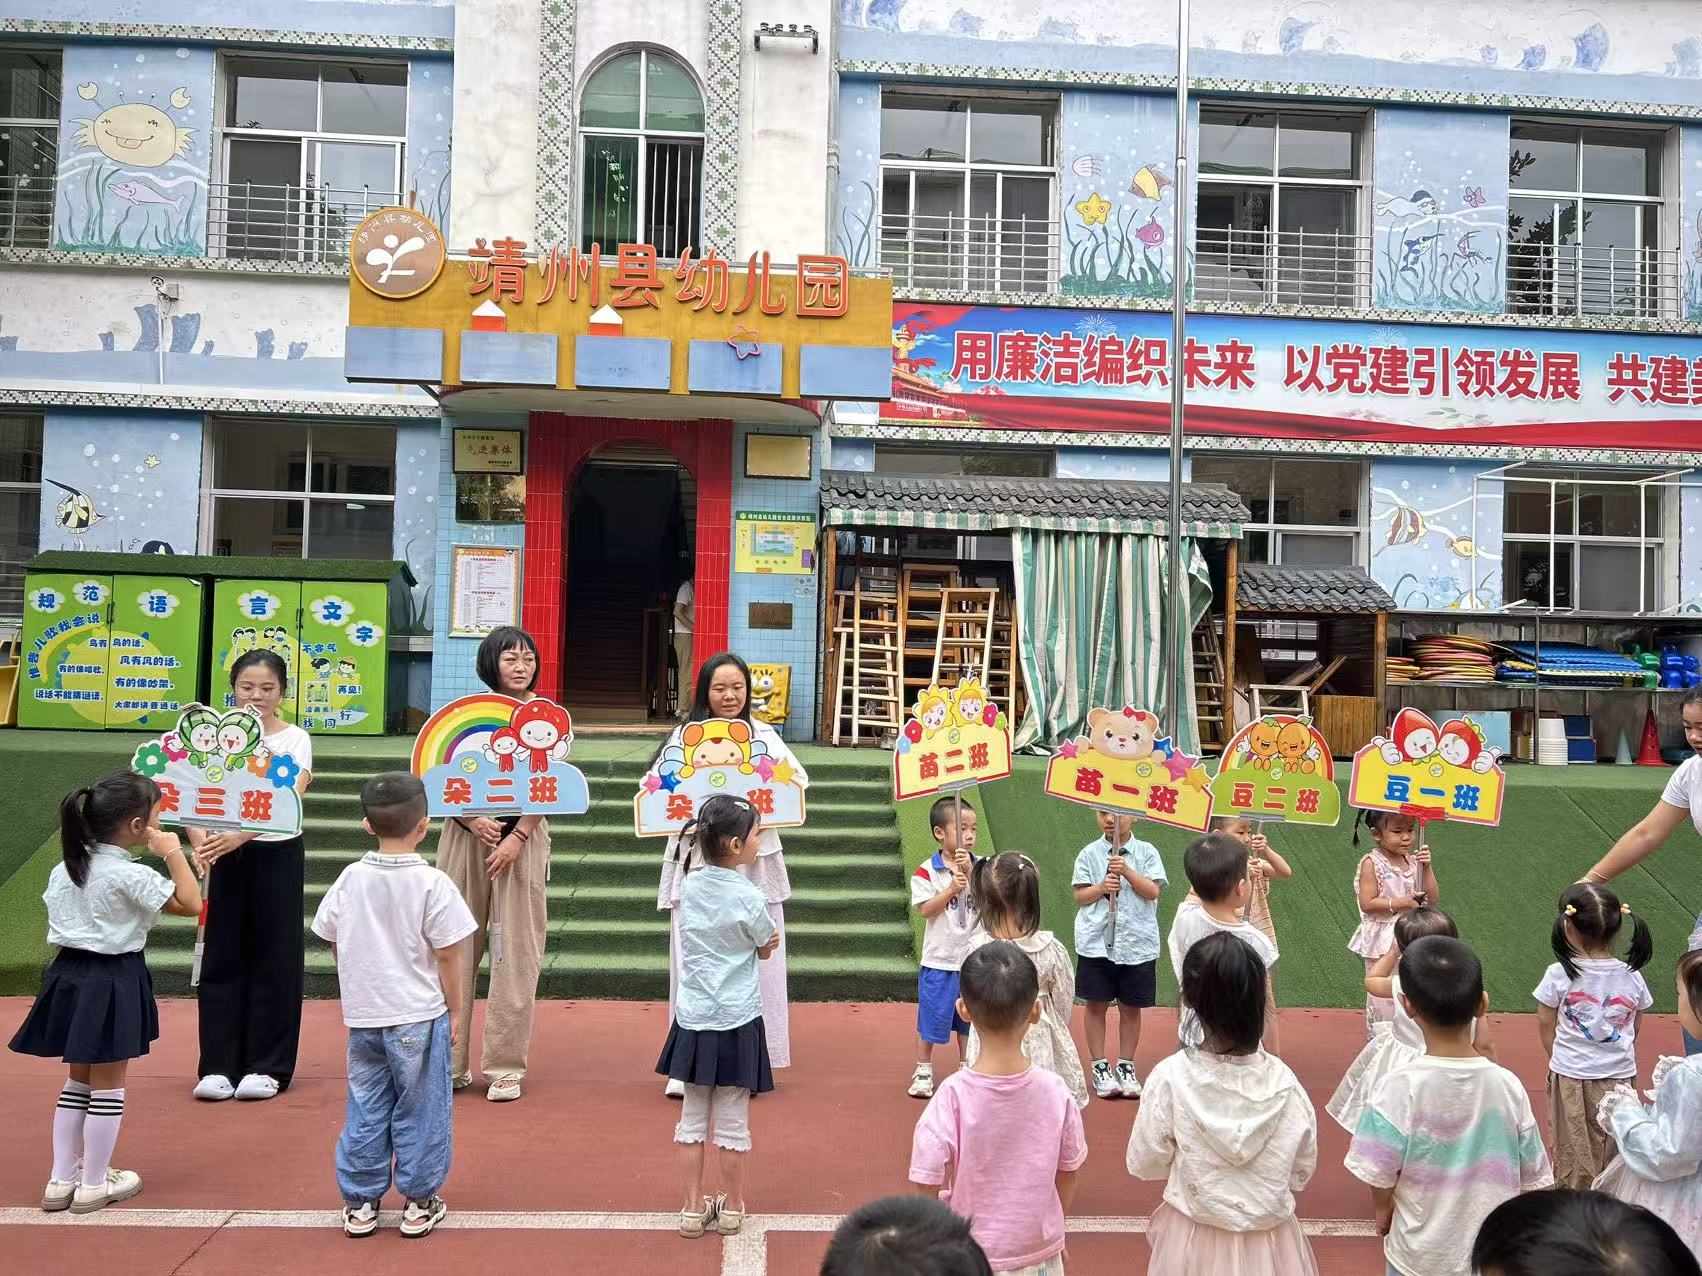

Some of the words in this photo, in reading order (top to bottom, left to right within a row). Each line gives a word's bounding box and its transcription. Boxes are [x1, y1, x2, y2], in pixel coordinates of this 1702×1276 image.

[467, 235, 849, 317] 靖州县幼儿园
[951, 330, 1255, 390] 用廉洁编织未来
[1283, 343, 1581, 401] 以党建引领发展
[1607, 353, 1702, 406] 共建
[919, 742, 989, 779] 苗二班
[443, 776, 558, 805] 朵二班
[666, 788, 774, 820] 朵班
[1075, 767, 1179, 814] 苗一班
[1231, 783, 1320, 813] 豆二班
[1384, 775, 1480, 811] 豆一班
